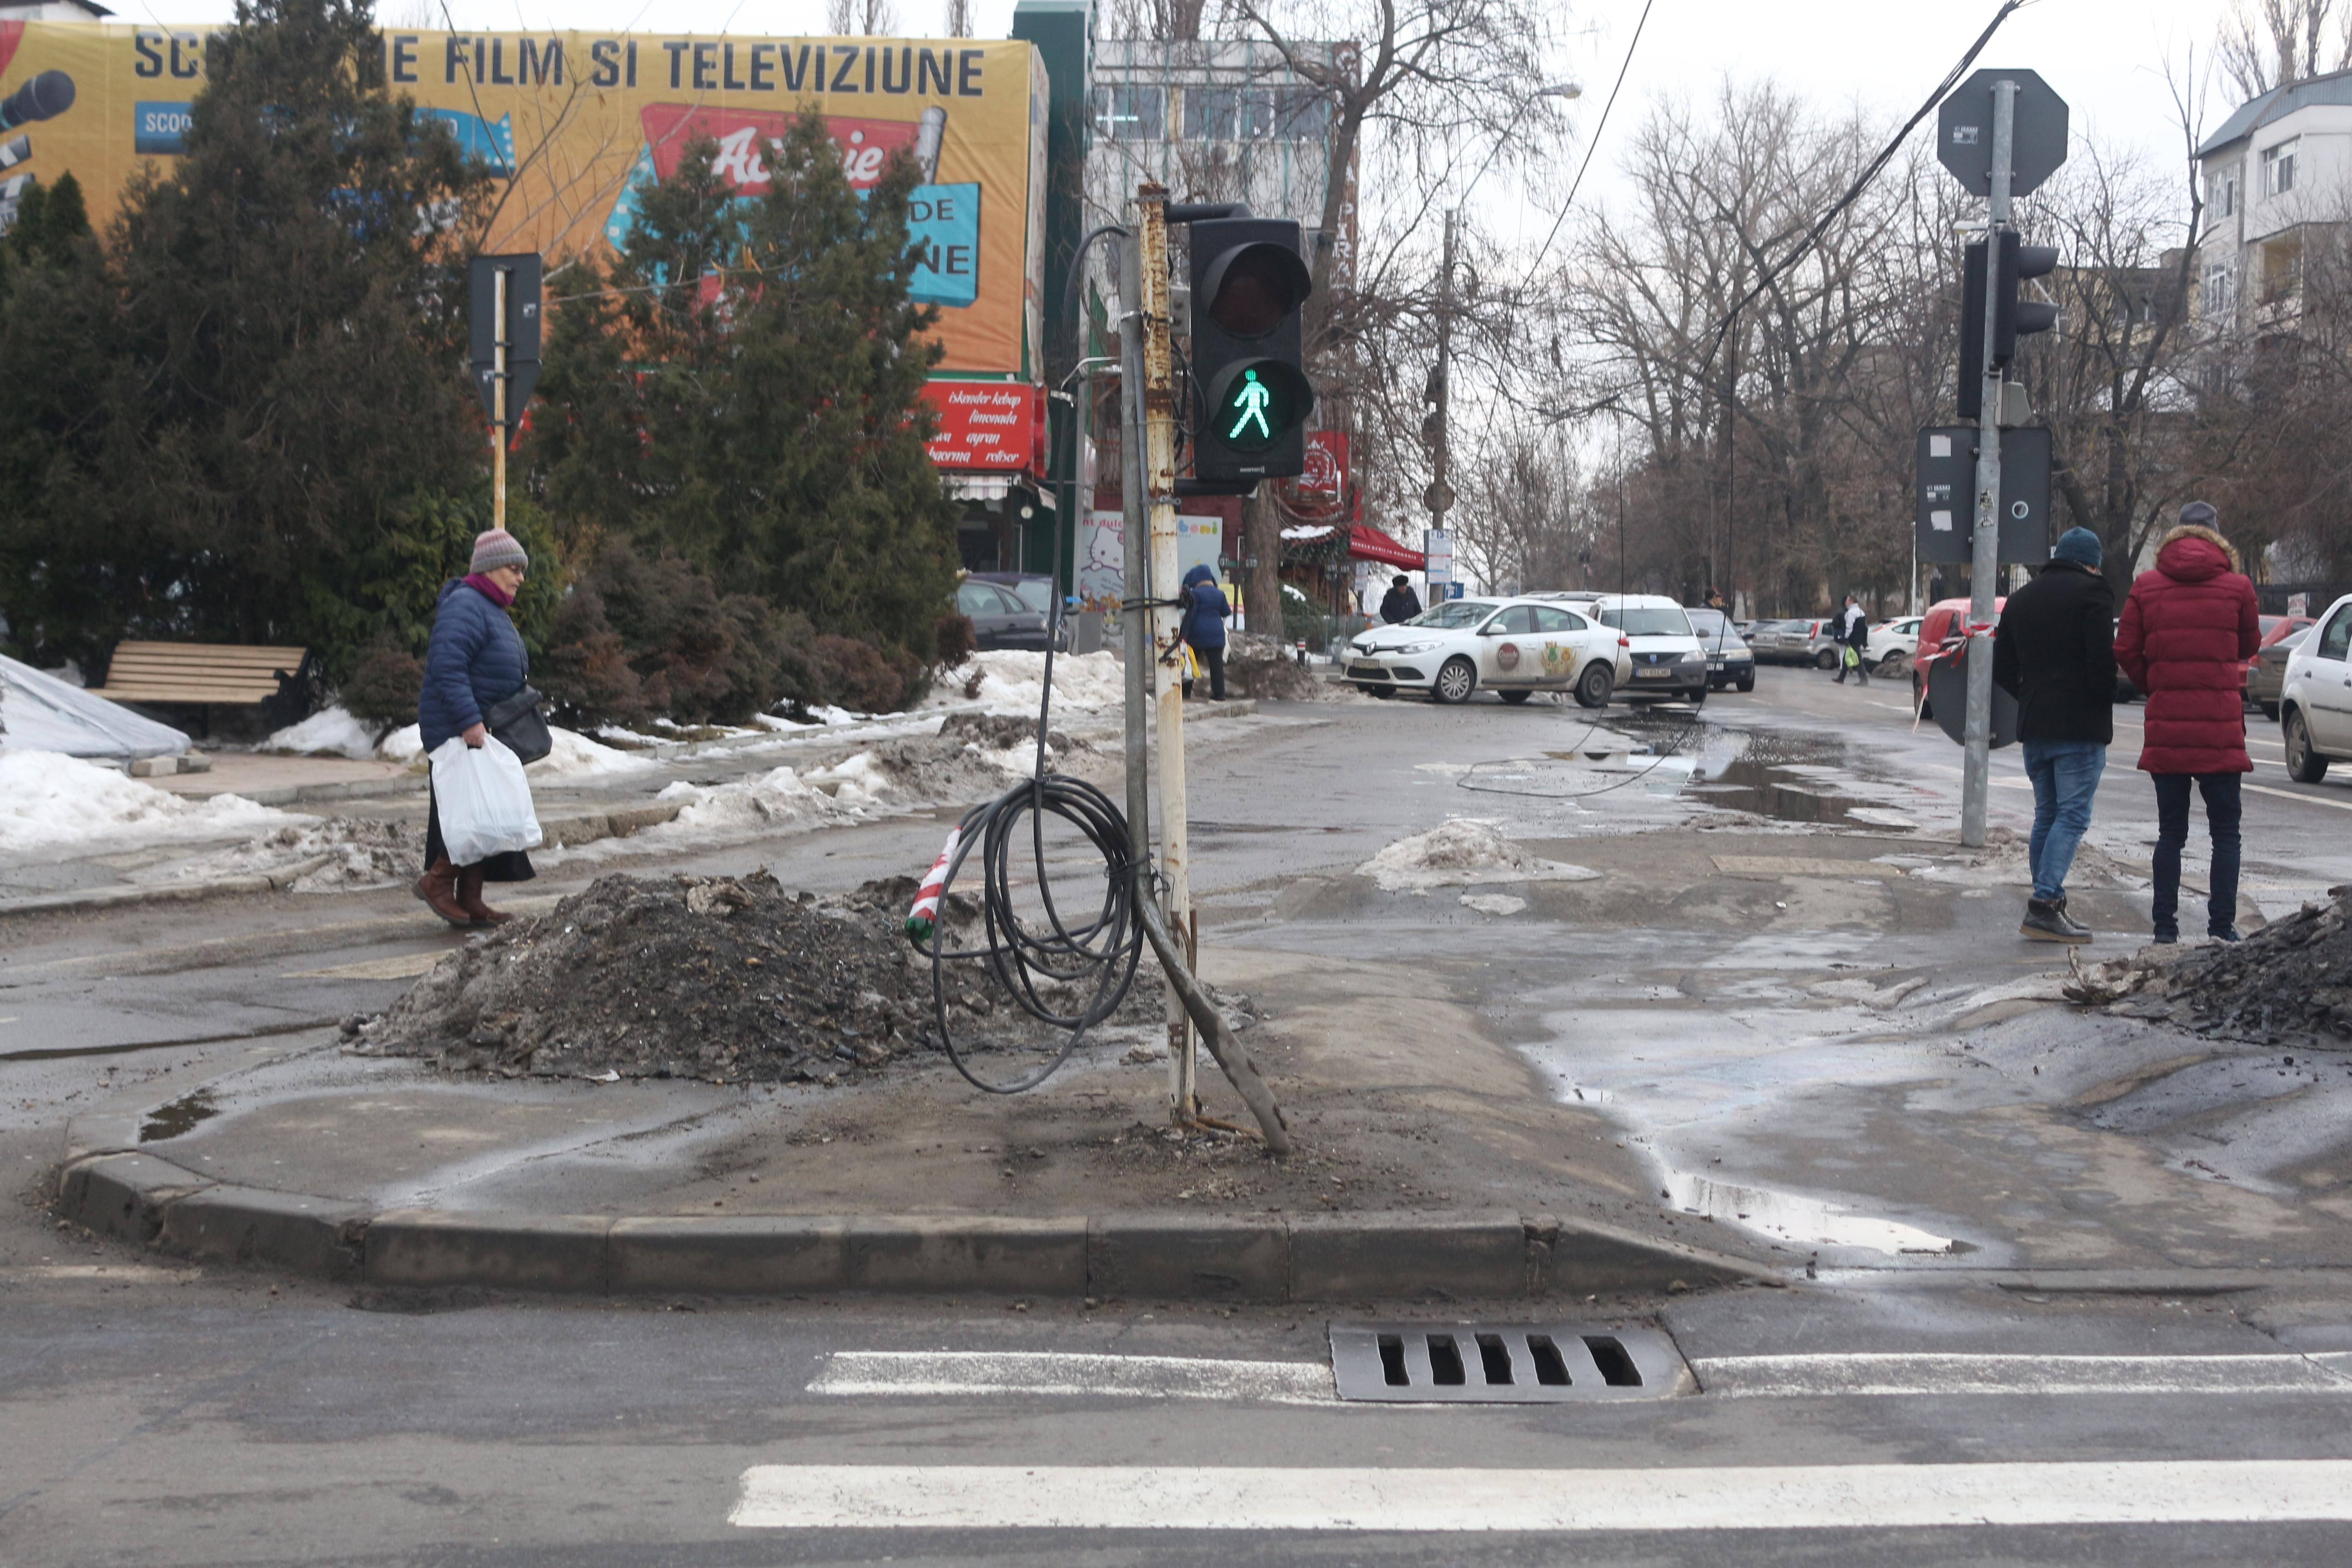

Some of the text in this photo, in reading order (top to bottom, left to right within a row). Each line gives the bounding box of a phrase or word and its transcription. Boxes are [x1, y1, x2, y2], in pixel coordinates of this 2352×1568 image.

[135, 31, 210, 78] SC
[446, 37, 564, 85] FILM
[593, 40, 637, 87] SI
[663, 41, 984, 96] TELEVIZIUNE
[146, 112, 193, 133] SCOO
[909, 198, 955, 223] DE
[910, 244, 970, 273] NE
[948, 390, 1021, 409] iskender kebap
[969, 409, 1018, 426] limonada
[966, 432, 1000, 447] ayran
[929, 446, 971, 463] haorma
[1083, 517, 1123, 528] nt dulc
